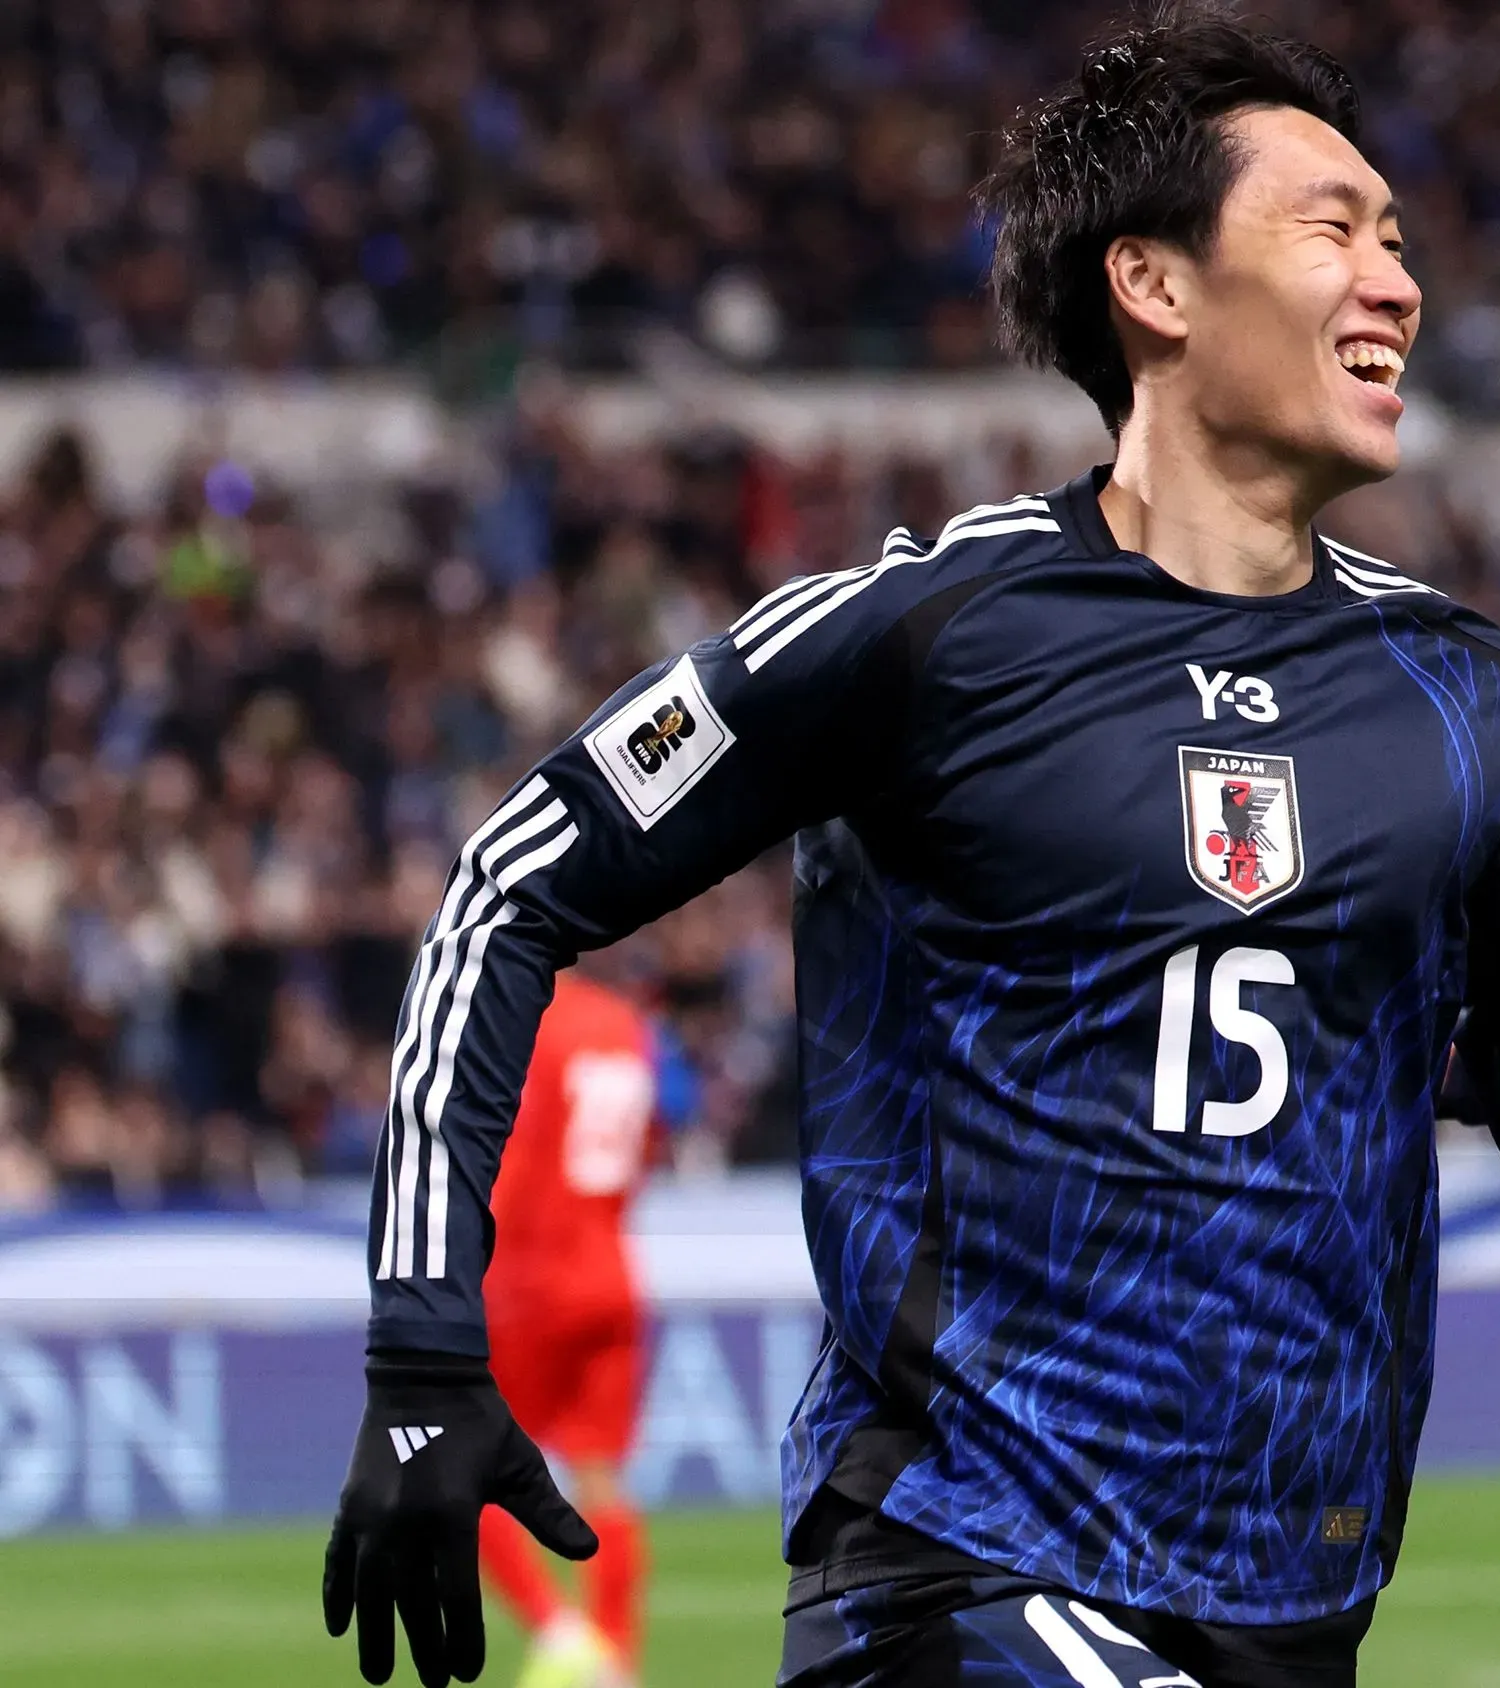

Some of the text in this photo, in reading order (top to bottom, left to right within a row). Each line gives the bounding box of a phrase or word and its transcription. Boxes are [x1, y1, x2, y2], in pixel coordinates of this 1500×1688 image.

[1185, 663, 1280, 723] Y-3
[616, 745, 647, 787] QUALIFIERS
[635, 742, 652, 766] FIFA
[1207, 756, 1266, 774] JAPAN
[1153, 943, 1296, 1138] 15
